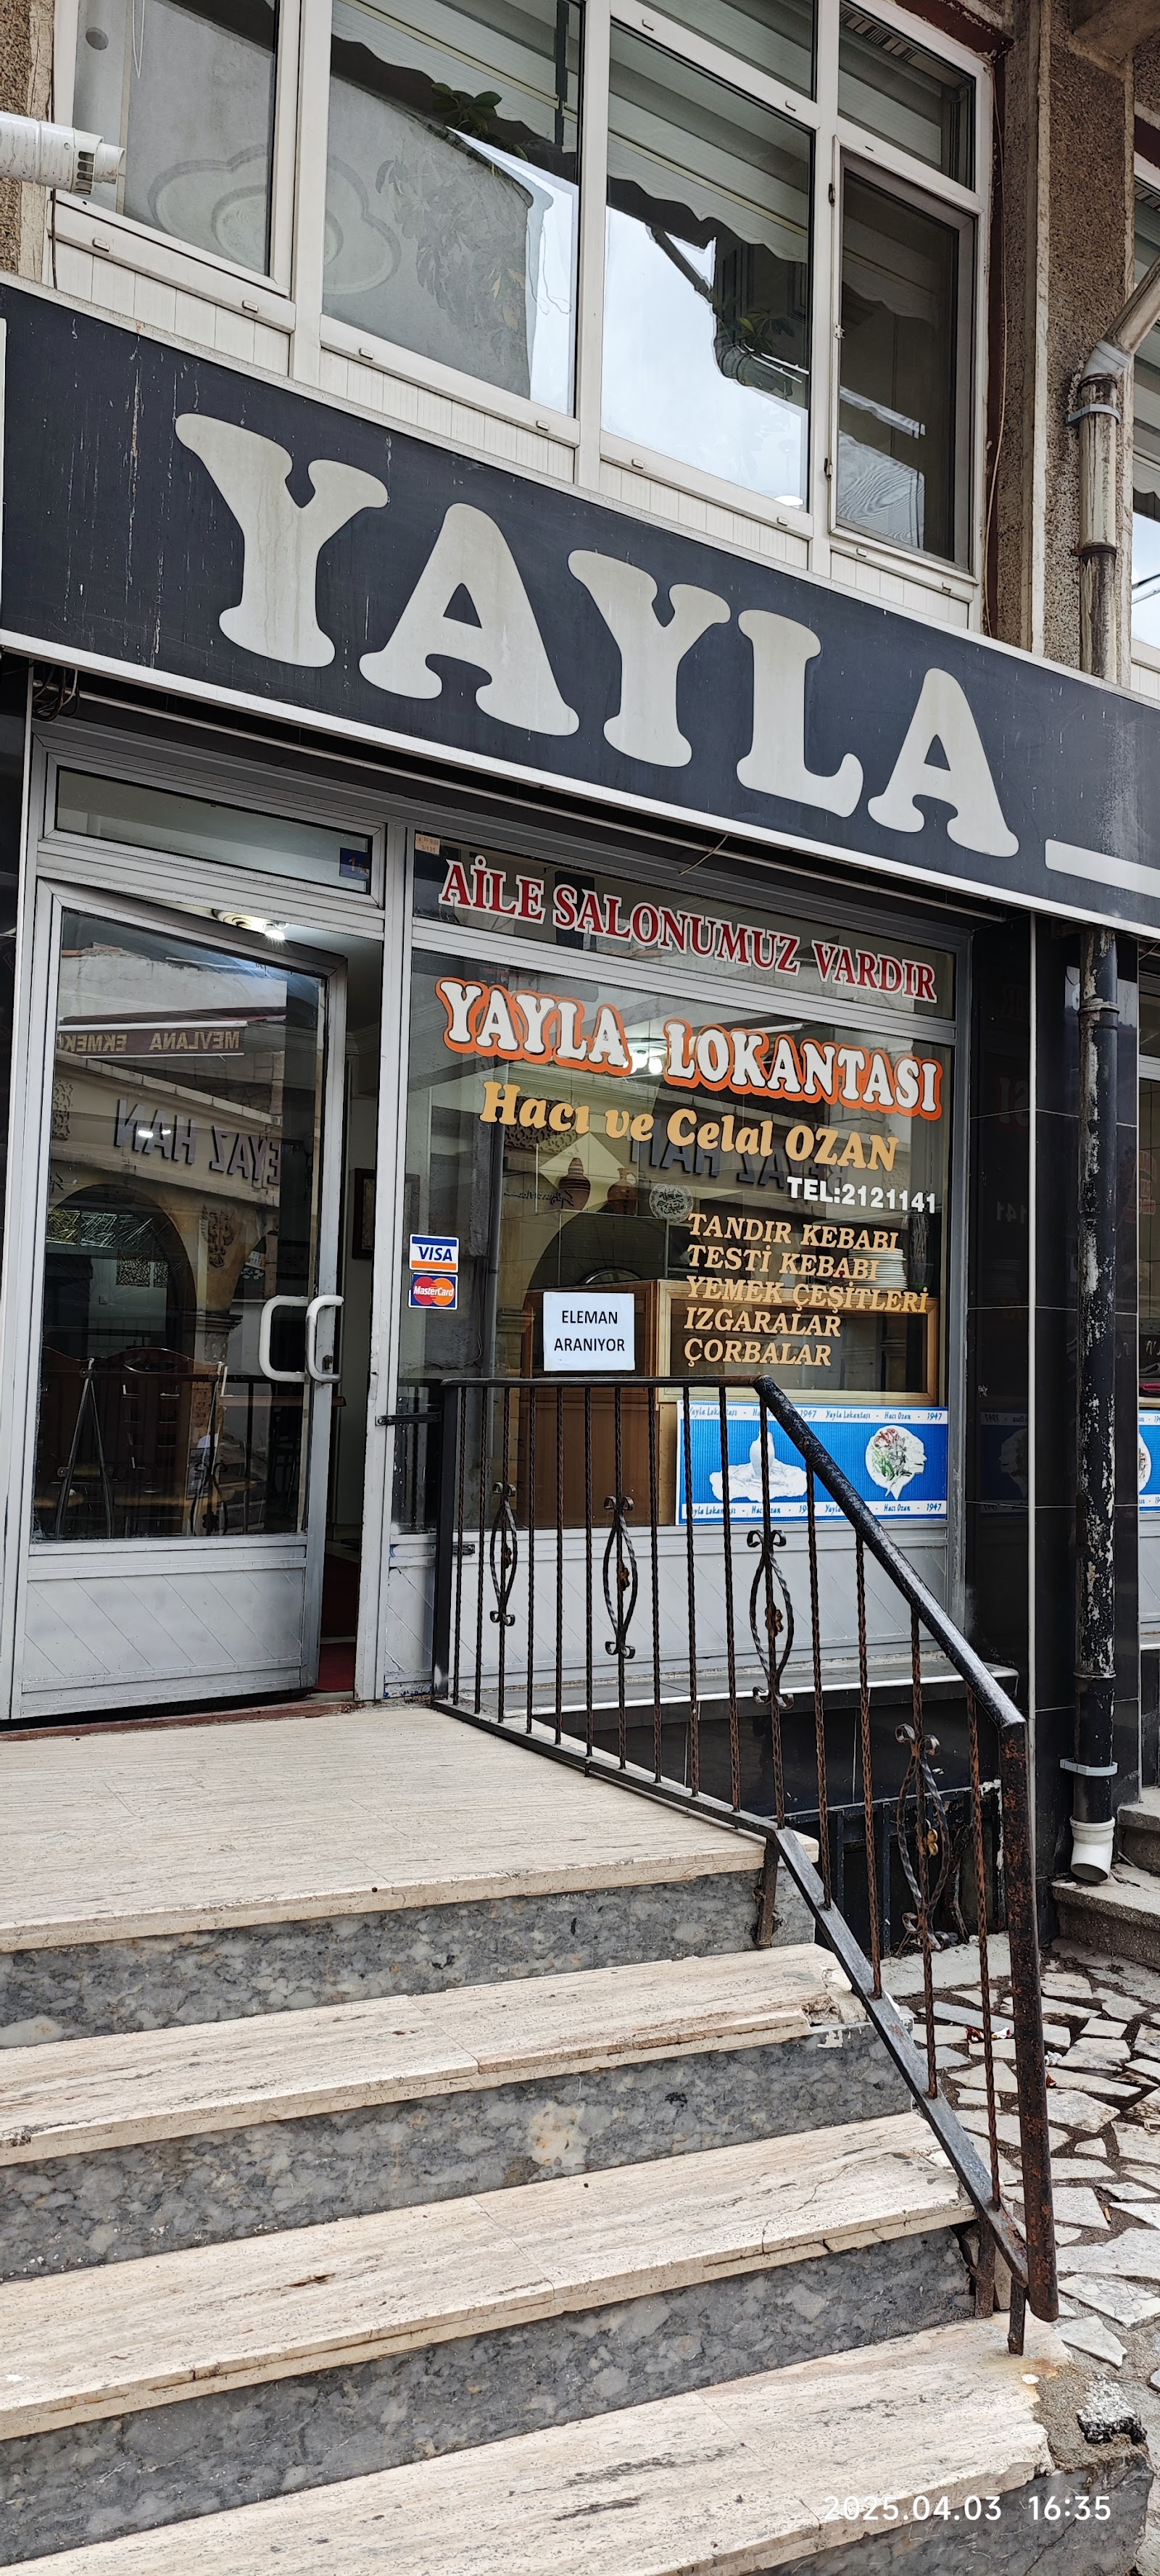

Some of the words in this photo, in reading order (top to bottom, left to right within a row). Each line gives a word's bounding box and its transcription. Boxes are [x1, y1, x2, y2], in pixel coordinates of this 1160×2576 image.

[175, 413, 1019, 857] YAYLA
[438, 855, 546, 924] AİLE
[552, 884, 800, 976] SALONUMUZ
[811, 939, 937, 1003] VARDIR
[436, 977, 632, 1078] YAYLA
[663, 1018, 942, 1121] LOKANTASI
[480, 1081, 589, 1134] Hacı
[605, 1109, 655, 1142] ve
[667, 1108, 774, 1157] Celal
[785, 1125, 899, 1172] OZAN
[787, 1176, 935, 1213] TEL:2121141
[688, 1213, 792, 1244] TANDIR
[800, 1224, 899, 1252] KEBABI
[416, 1246, 453, 1262] VISA
[687, 1245, 773, 1273] TESTİ
[779, 1252, 880, 1281] KEBABI
[413, 1285, 454, 1297] MasterCard
[687, 1275, 784, 1304] YEMEK
[793, 1281, 929, 1313] ÇEŞİTLERİ
[562, 1310, 618, 1324] ELEMAN
[684, 1307, 841, 1338] IZGARALAR
[554, 1338, 625, 1352] ARANIYOR
[684, 1338, 831, 1367] ÇORBALAR
